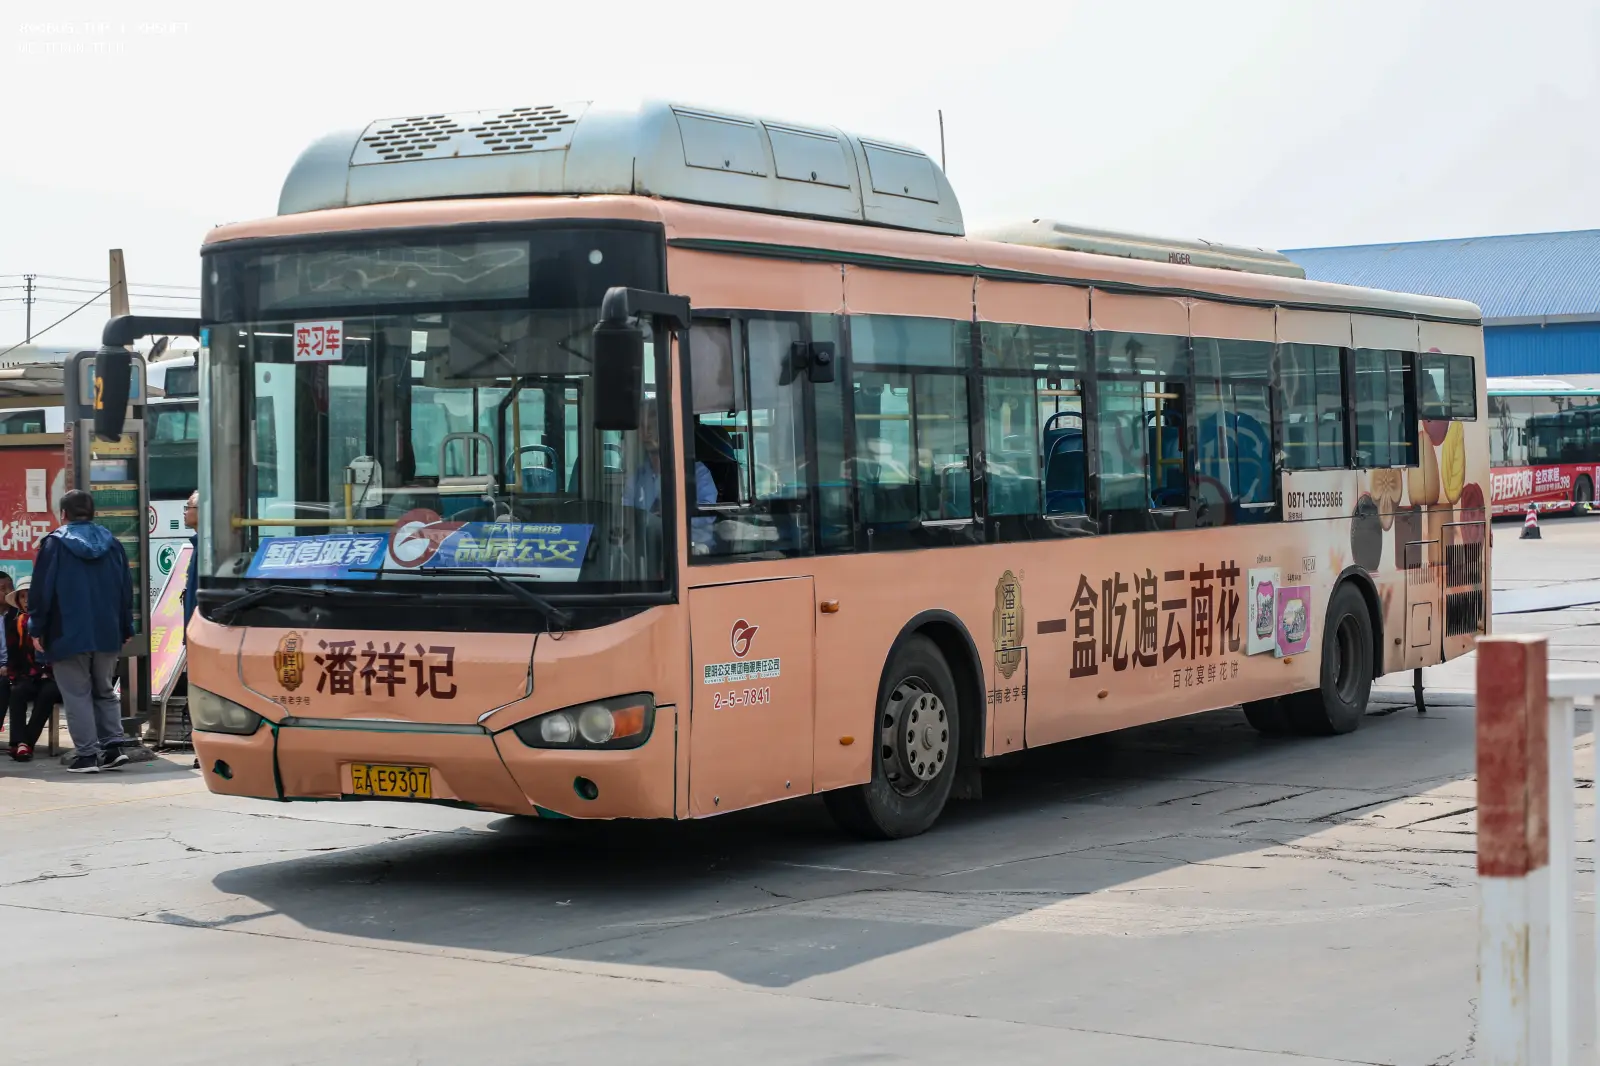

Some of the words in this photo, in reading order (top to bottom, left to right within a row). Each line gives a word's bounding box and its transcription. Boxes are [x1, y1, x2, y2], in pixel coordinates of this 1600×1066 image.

[1169, 252, 1191, 265] HIGER
[297, 325, 340, 356] 实习车
[1287, 491, 1343, 508] 0871-65939866
[259, 537, 382, 568] 暂停服务
[455, 538, 579, 562] 品质公交
[1303, 558, 1316, 572] NEW
[1037, 560, 1241, 679] 一盒吃遍云南花
[313, 639, 458, 699] 潘祥记
[704, 658, 780, 678] 昆明公交集团有限责任公司
[1173, 660, 1239, 689] 百花宴鲜花饼
[714, 687, 770, 709] 2-5-7841
